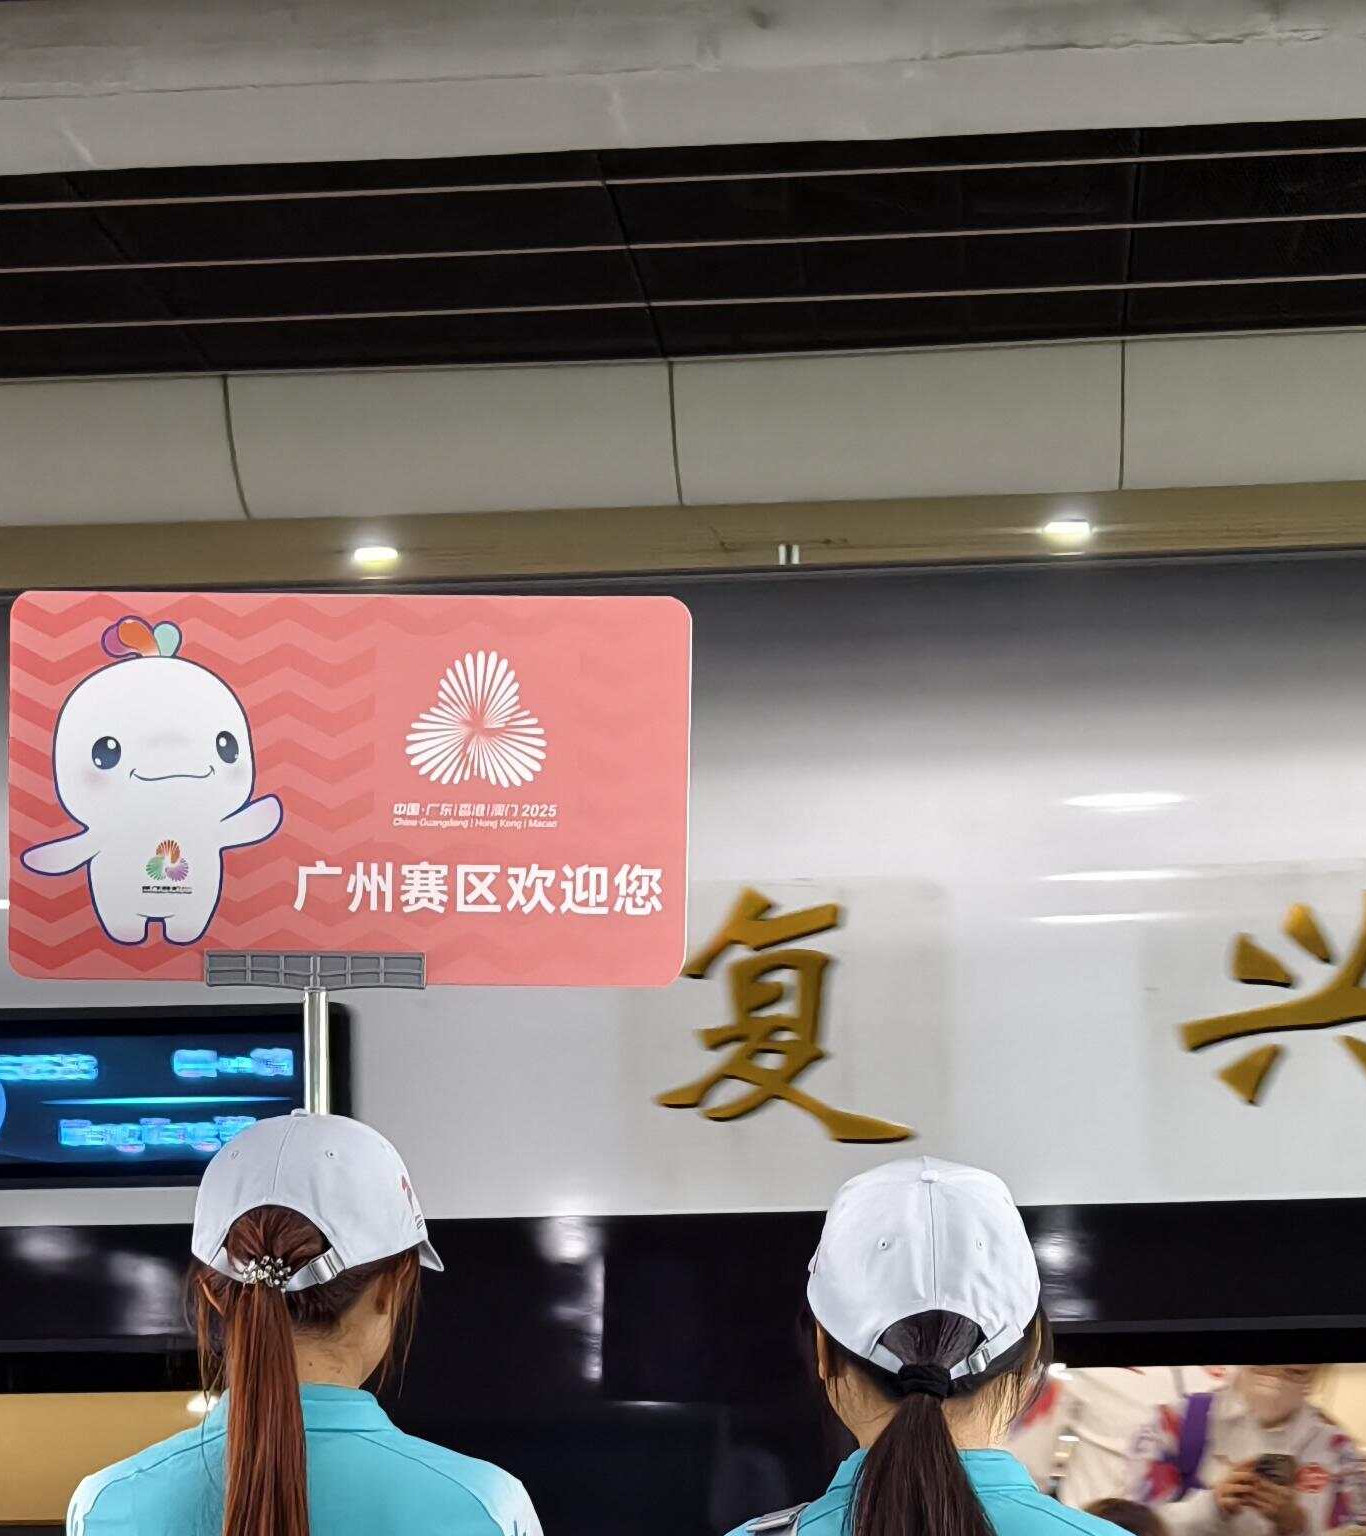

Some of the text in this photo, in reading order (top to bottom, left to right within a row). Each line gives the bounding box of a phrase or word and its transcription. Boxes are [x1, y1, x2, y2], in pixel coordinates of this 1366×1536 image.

[522, 803, 558, 817] 2025
[292, 859, 663, 916] 广州赛区欢迎您
